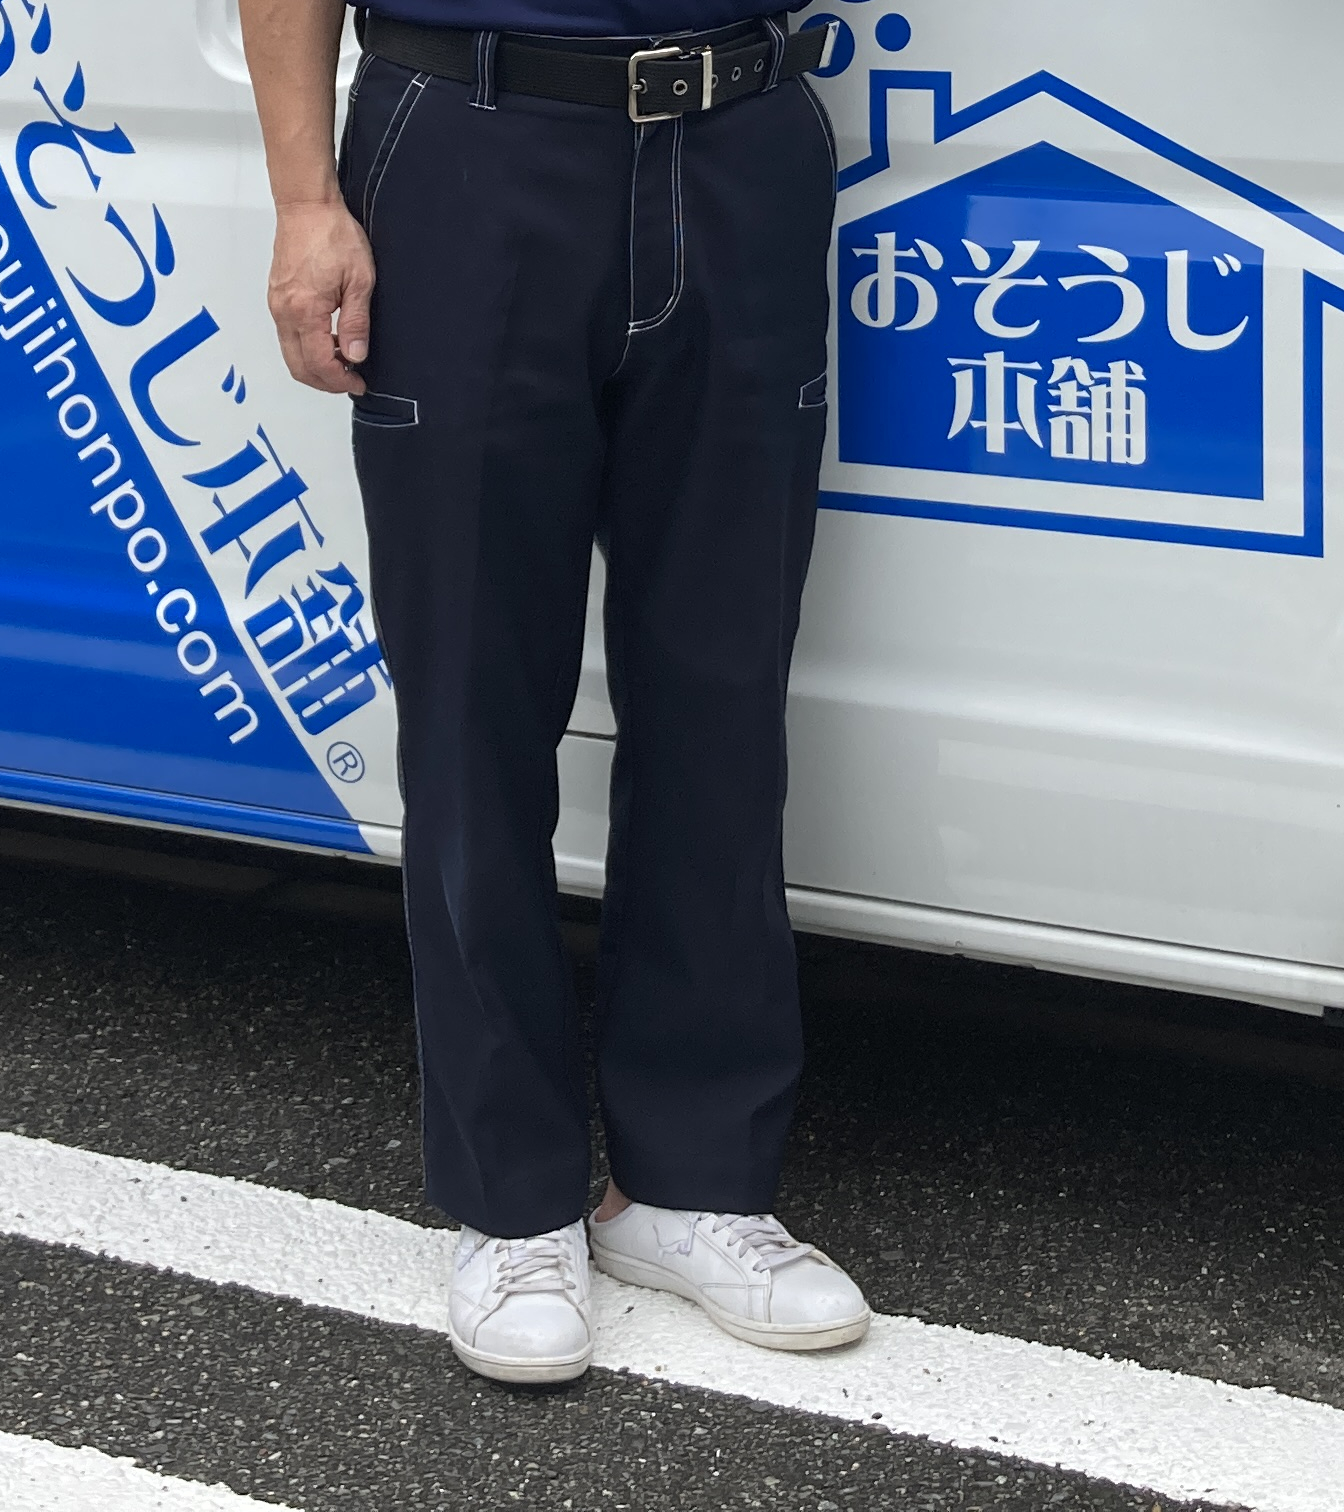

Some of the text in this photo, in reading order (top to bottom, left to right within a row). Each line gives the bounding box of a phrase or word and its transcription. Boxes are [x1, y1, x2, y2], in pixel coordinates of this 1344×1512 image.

[850, 231, 1250, 351] おそうじ
[946, 350, 1147, 466] 本舗
